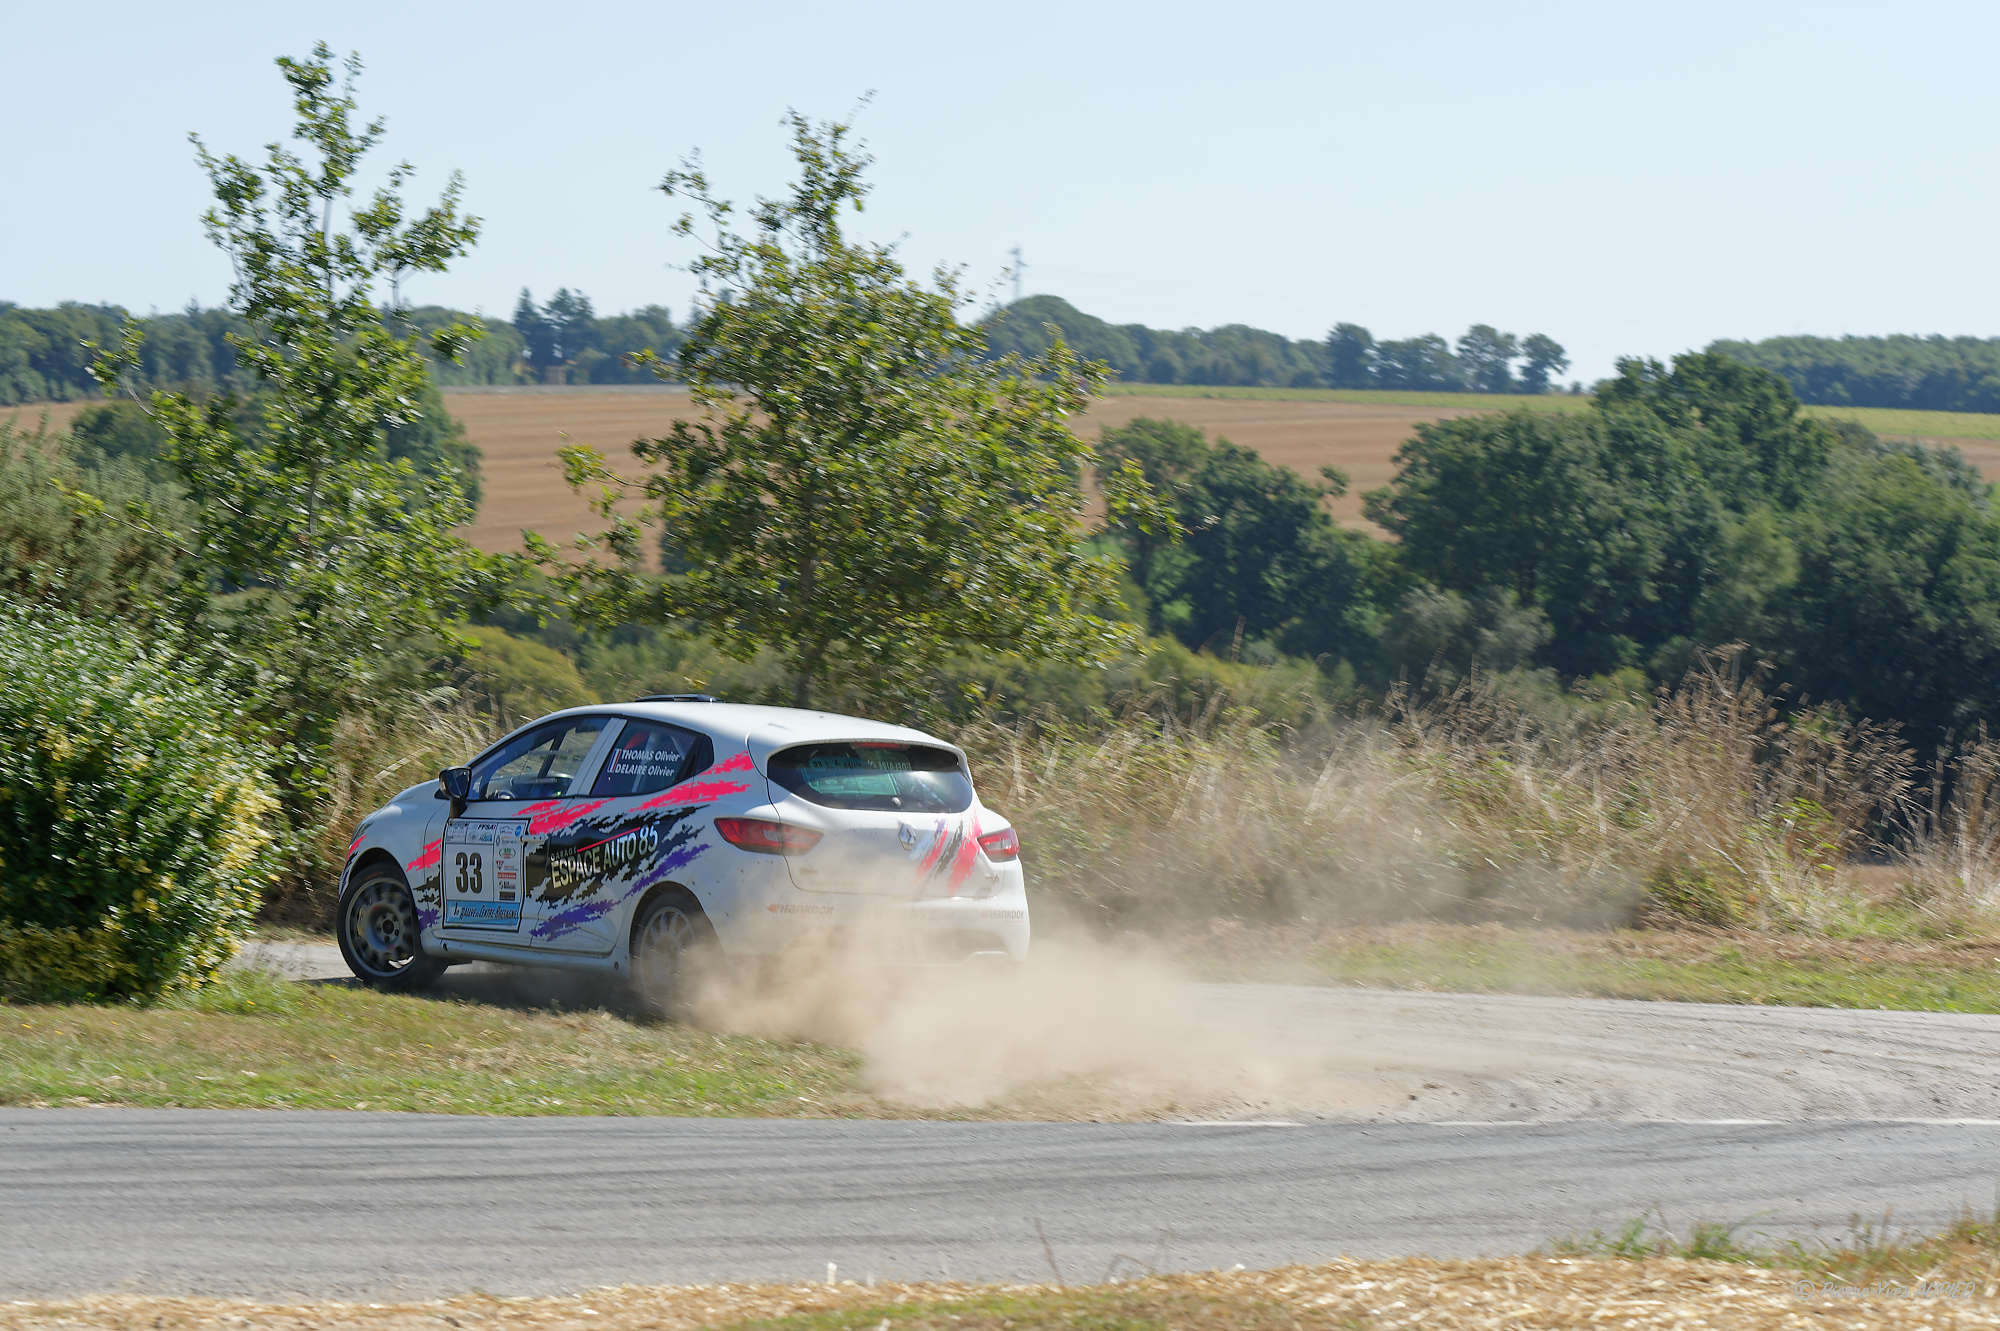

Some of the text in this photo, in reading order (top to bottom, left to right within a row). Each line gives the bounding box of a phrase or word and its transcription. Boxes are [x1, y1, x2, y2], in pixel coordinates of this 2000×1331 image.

[615, 763, 675, 777] DELAIRE Olivier
[621, 749, 680, 762] THOMAS Olivier
[551, 820, 660, 889] ESPACE AUTO 85
[455, 851, 483, 895] 33
